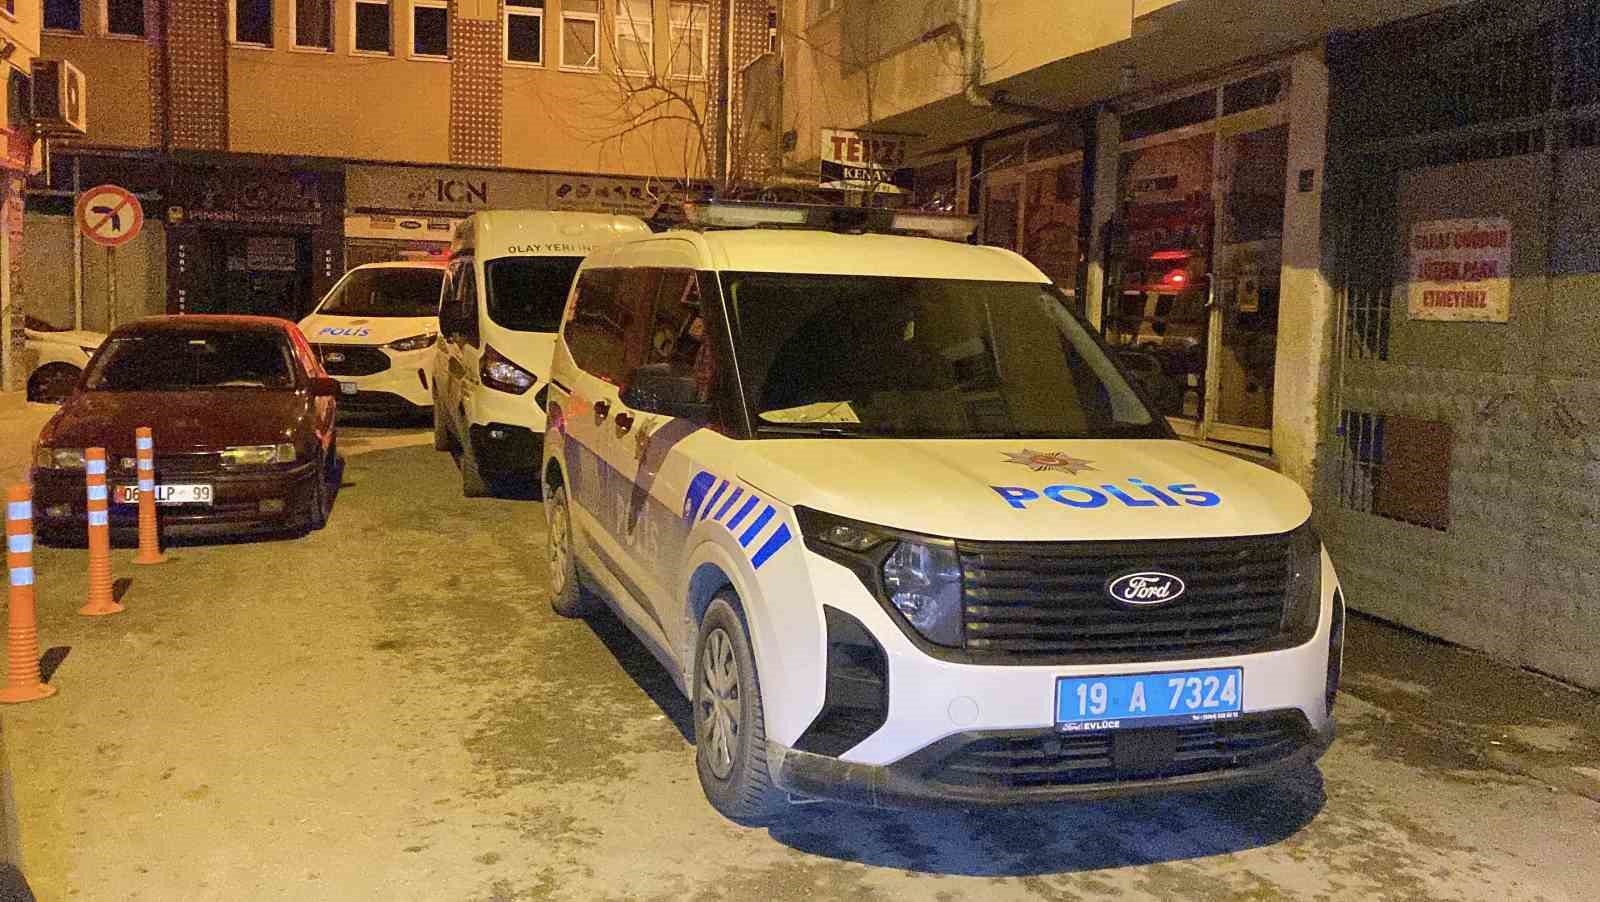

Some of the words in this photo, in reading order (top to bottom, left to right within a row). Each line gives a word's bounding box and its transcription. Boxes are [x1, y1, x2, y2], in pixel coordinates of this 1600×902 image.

[508, 245, 541, 253] OLAY
[124, 487, 140, 501] 06
[193, 486, 210, 501] 99
[989, 477, 1221, 509] POLİS
[1124, 576, 1170, 599] Ford
[1076, 682, 1107, 716] 19
[1128, 681, 1146, 712] A
[1168, 674, 1237, 710] 7324
